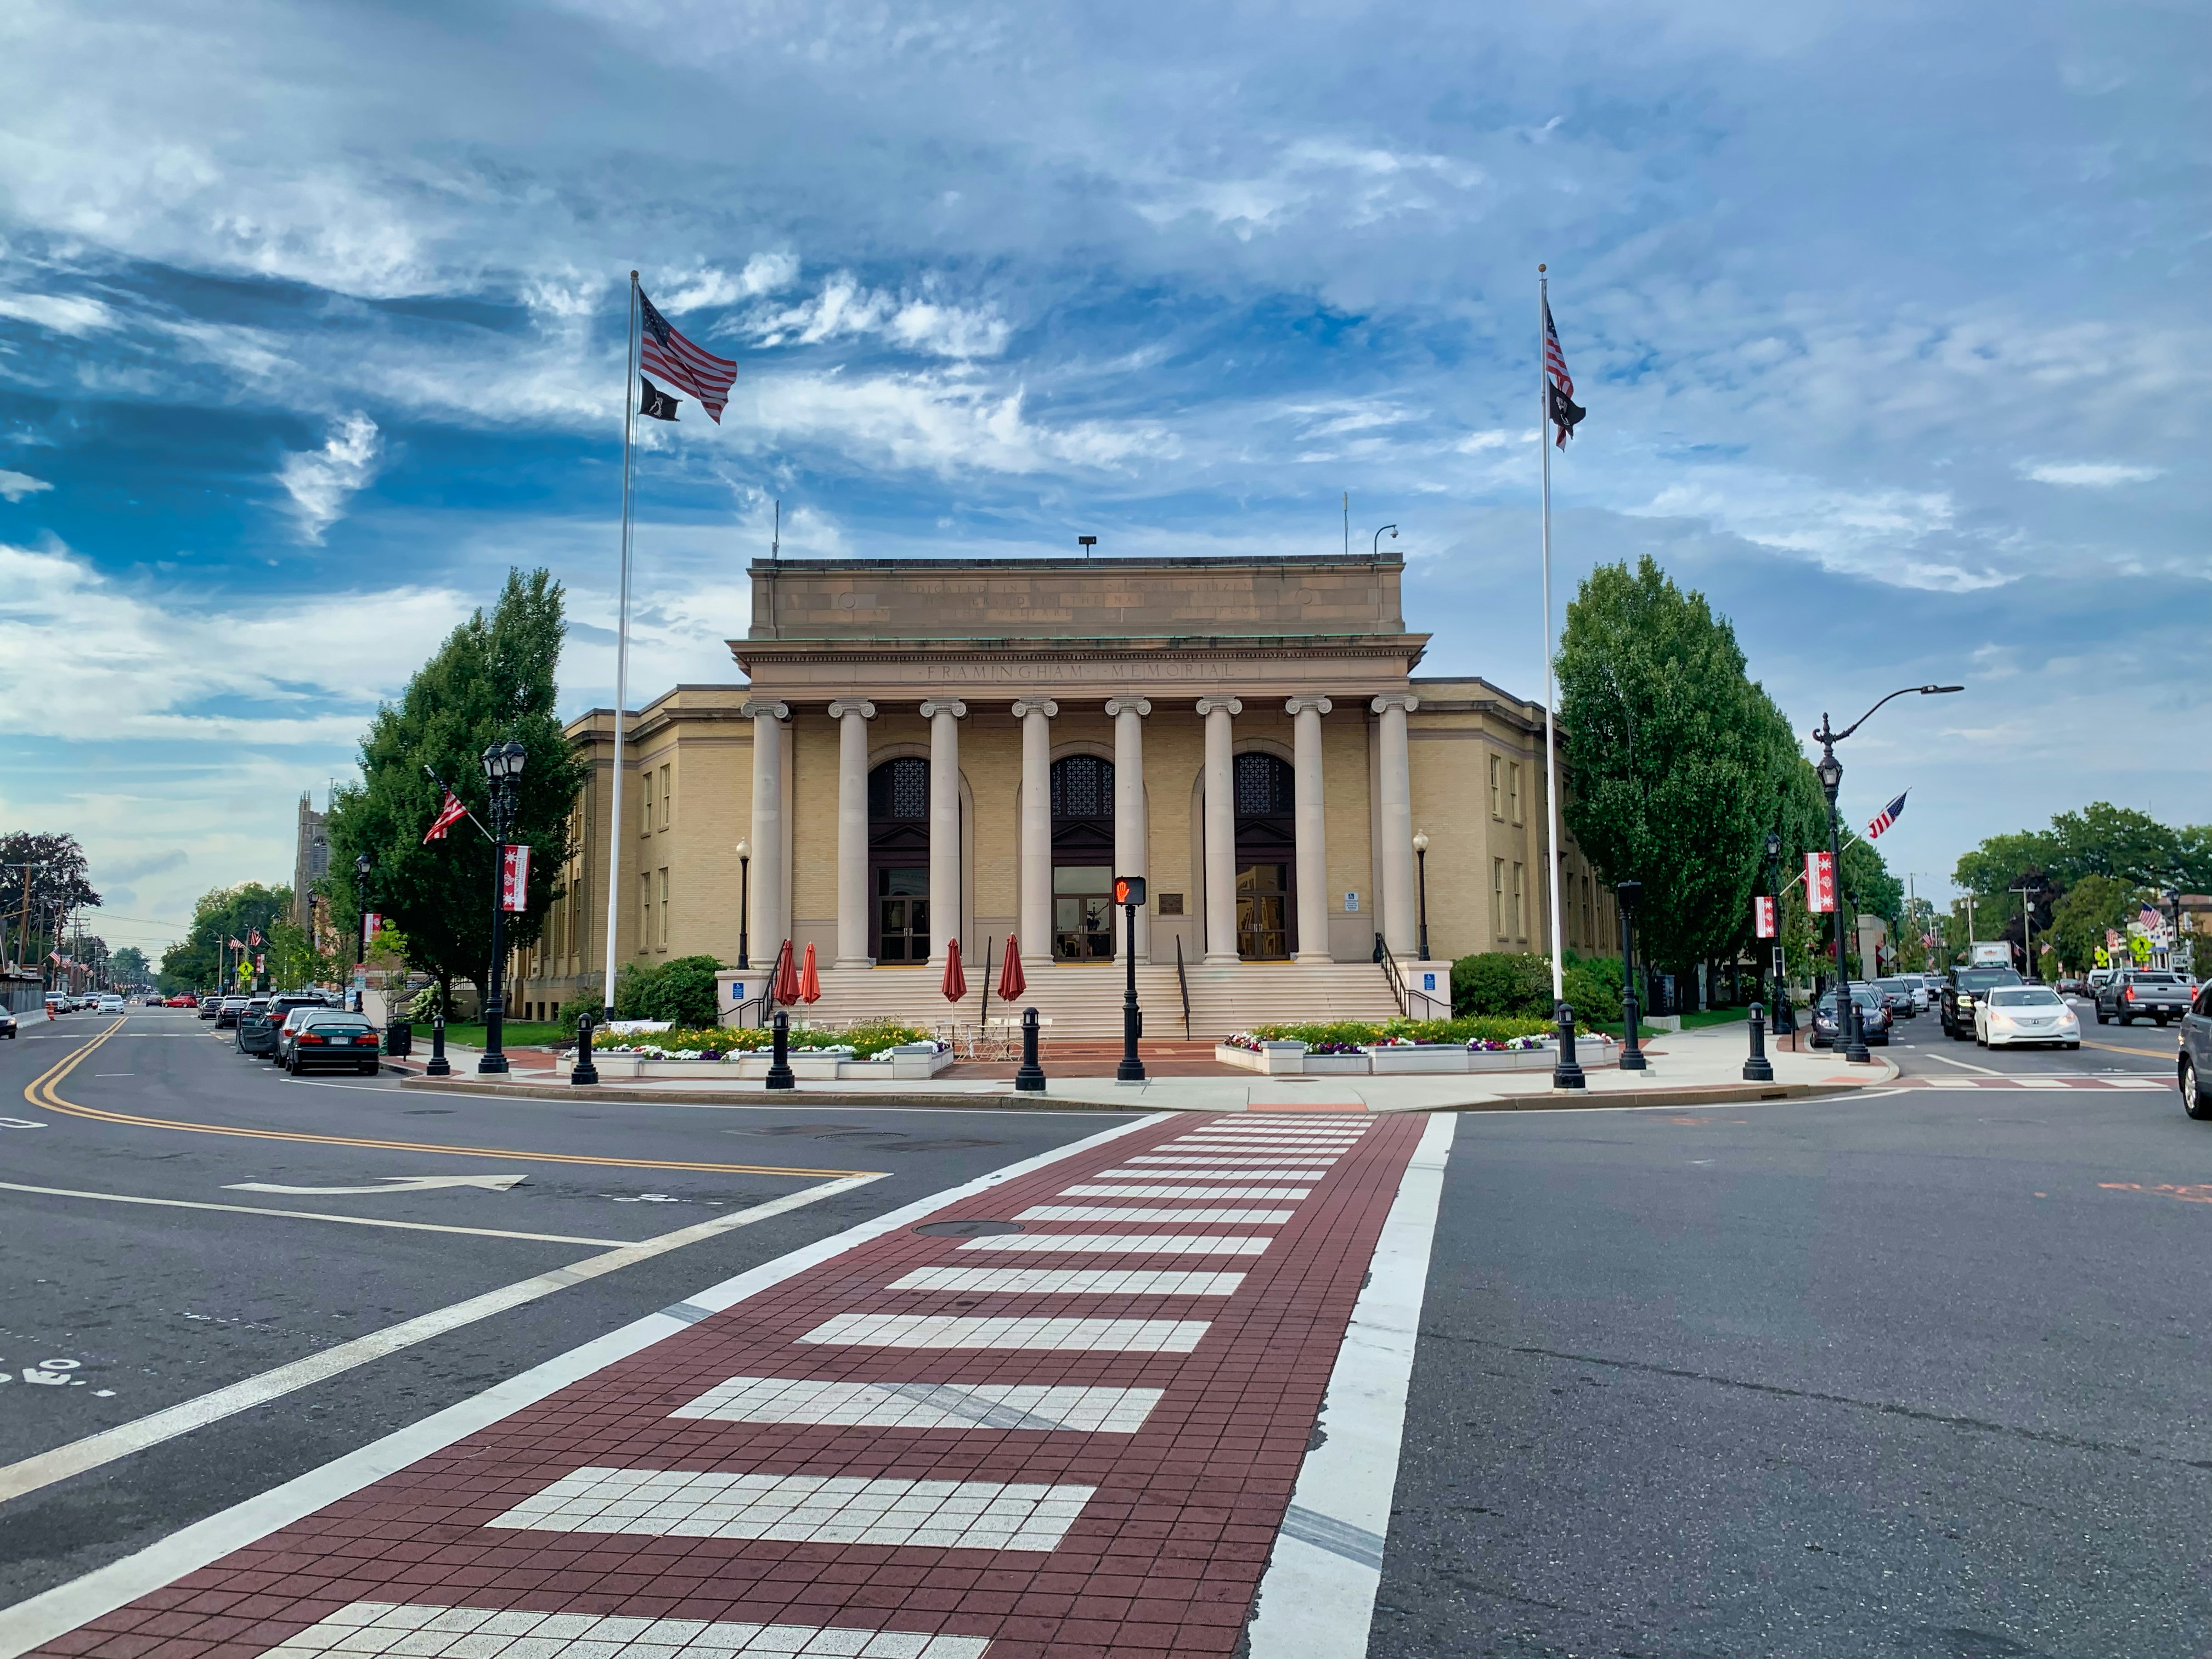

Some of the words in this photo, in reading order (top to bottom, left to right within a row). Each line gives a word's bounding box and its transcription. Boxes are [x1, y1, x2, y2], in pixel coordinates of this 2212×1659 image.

[1070, 596, 1100, 604] THE
[997, 607, 1072, 617] WELFARE
[927, 664, 1083, 679] FRAMINGHAM
[1111, 663, 1235, 678] MEMORIAL
